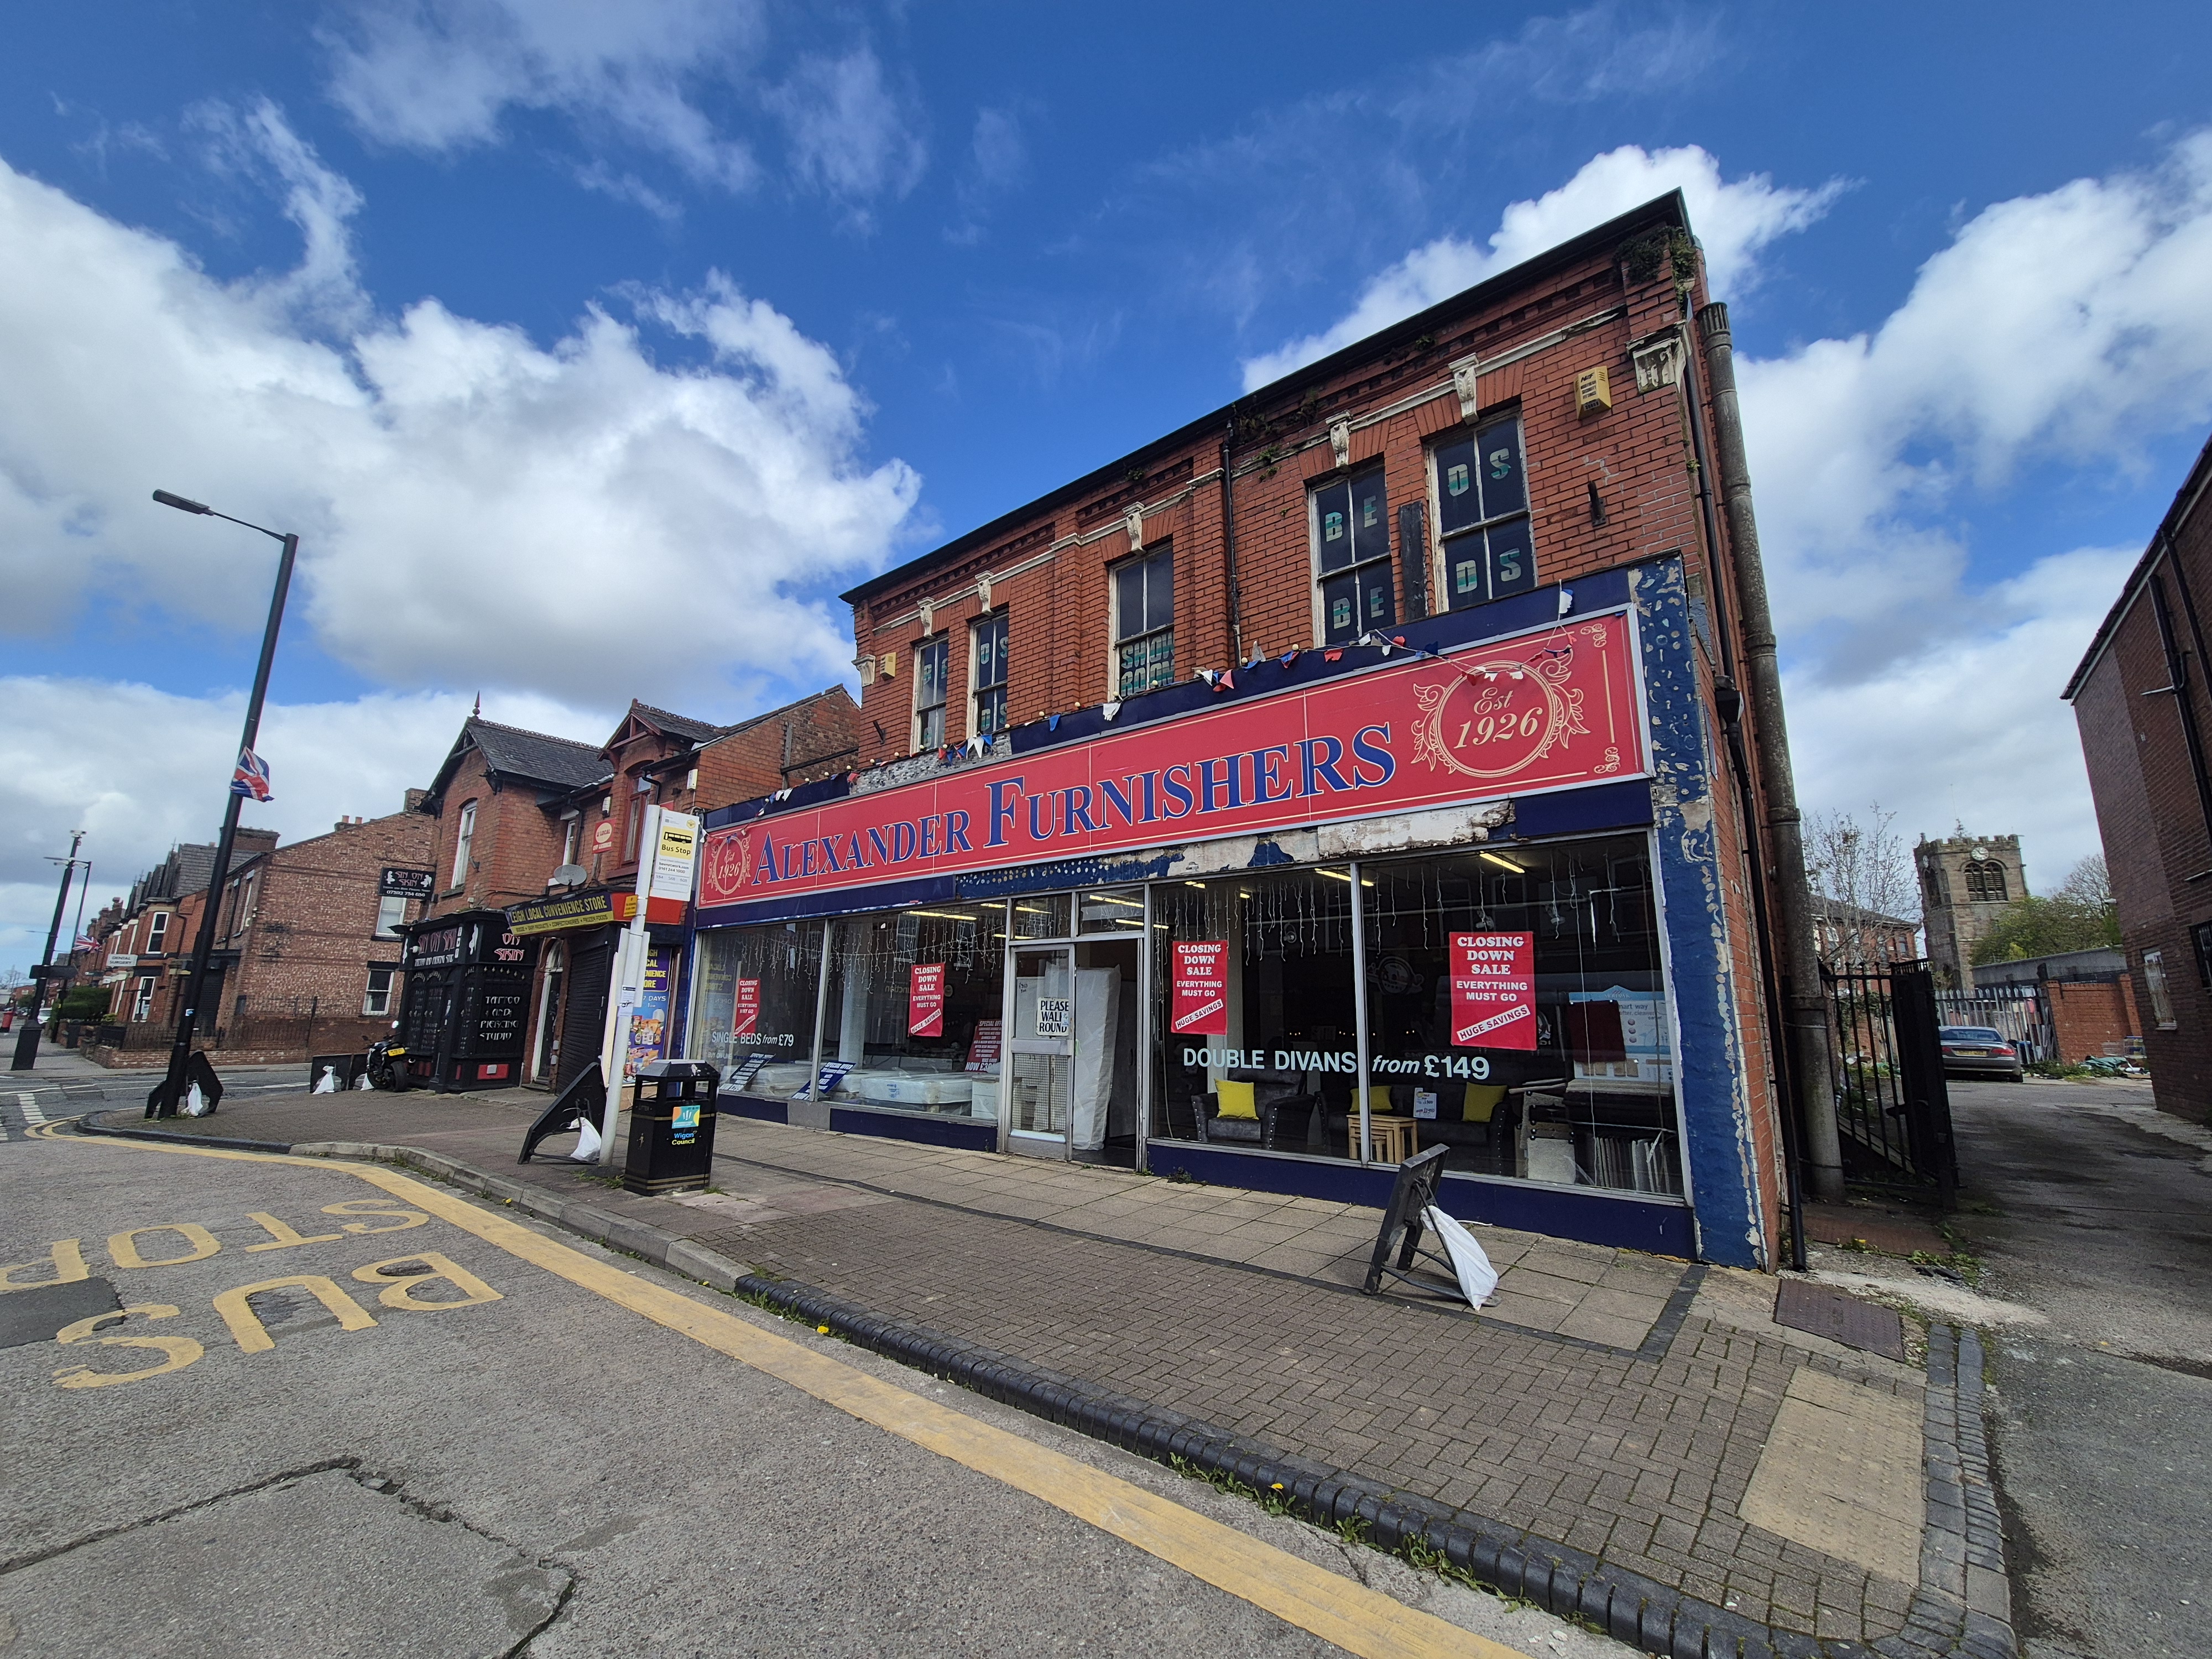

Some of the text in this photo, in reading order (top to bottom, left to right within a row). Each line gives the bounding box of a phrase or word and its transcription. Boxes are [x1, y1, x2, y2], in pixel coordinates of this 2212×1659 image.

[1474, 687, 1514, 714] Est
[1454, 707, 1543, 748] 1926
[751, 721, 1396, 886] ALEXANDER FURNISHERS
[675, 847, 691, 855] Stop
[718, 862, 741, 879] 1926
[509, 896, 607, 923] LEIGH LOCAL CONVENIENCE STORE
[1457, 936, 1524, 947] CLOSING
[1178, 944, 1221, 953] CLOSING
[494, 948, 524, 961] SKIN
[1184, 956, 1215, 964] DOWN
[1467, 950, 1515, 961] DOWN
[915, 966, 941, 974] CLOSING
[1186, 967, 1212, 975] SALE
[1471, 964, 1510, 975] SALE
[1457, 980, 1528, 990] EVERYTHING
[1041, 1000, 1069, 1011] PLEASE
[1177, 1001, 1222, 1028] HUGE SAVINGS
[481, 1020, 519, 1029] PIERCING
[912, 1010, 940, 1033] HUGE SAVINGS
[1459, 1007, 1528, 1040] HUGE SAVINGS
[1039, 1022, 1067, 1033] ROUND
[480, 1032, 512, 1041] STUDIO
[712, 1031, 794, 1047] SINGLE BEDS from £79
[965, 1062, 980, 1071] NOW
[1183, 1048, 1490, 1079] DOUBLE DIVANS from £149
[0, 1199, 430, 1291] STOP
[53, 1251, 505, 1389] BUS
